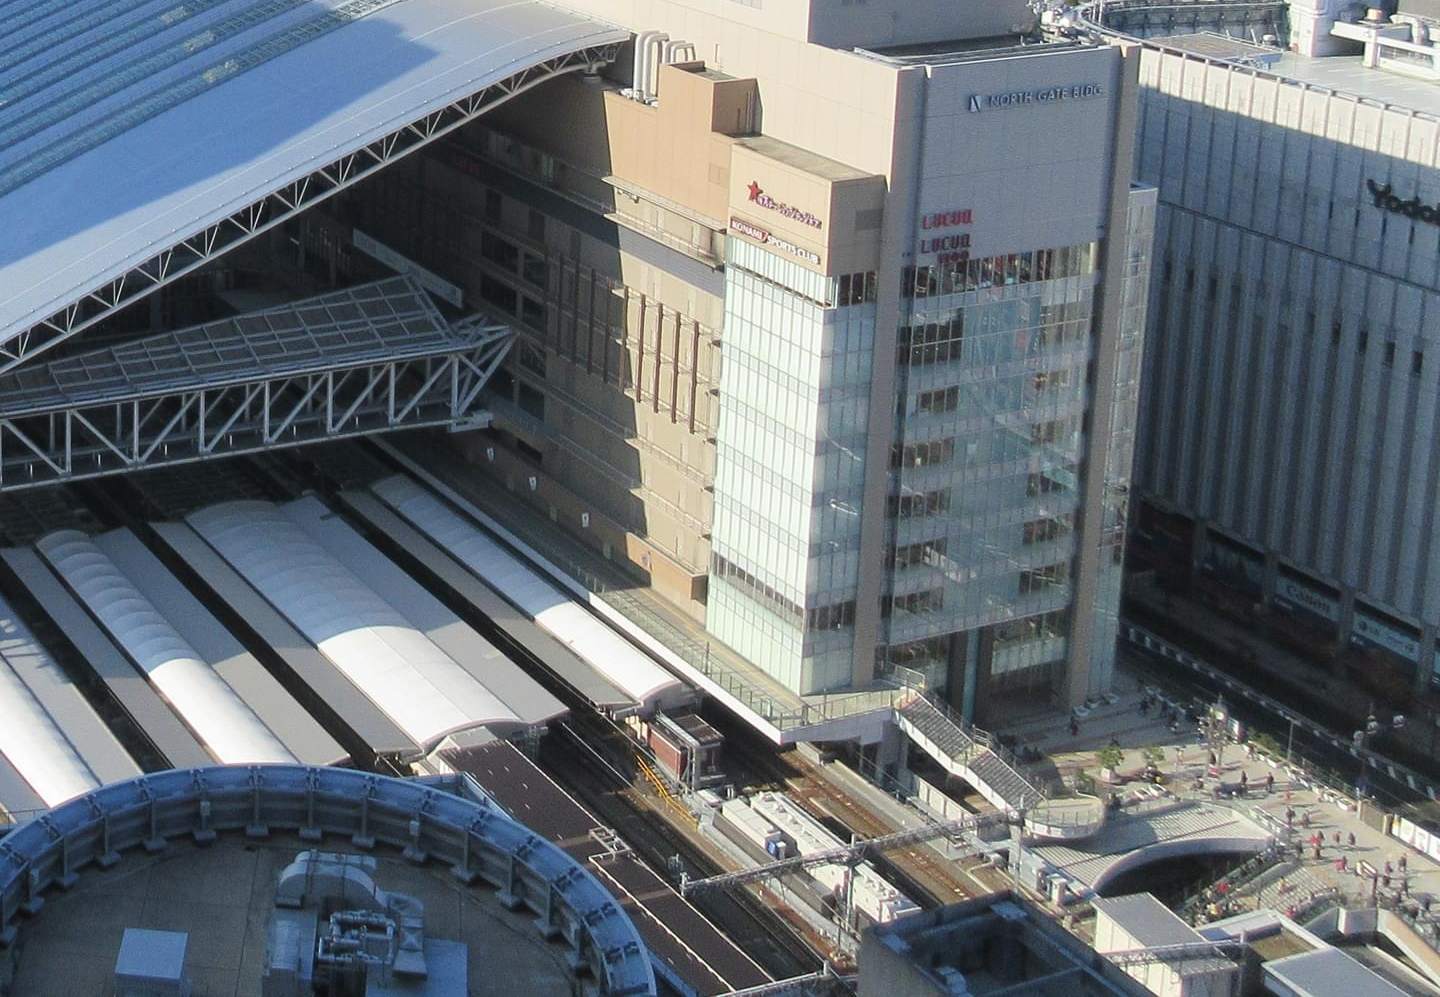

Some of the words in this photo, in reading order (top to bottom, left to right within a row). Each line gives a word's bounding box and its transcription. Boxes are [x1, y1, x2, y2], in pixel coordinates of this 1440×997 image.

[989, 91, 1033, 108] NORTH
[1038, 87, 1069, 103] GATE
[1072, 83, 1103, 100] BLDG
[731, 219, 764, 241] KONAMI
[767, 235, 796, 256] SPORTS
[797, 247, 821, 264] CLUB
[1285, 582, 1331, 614] Canon
